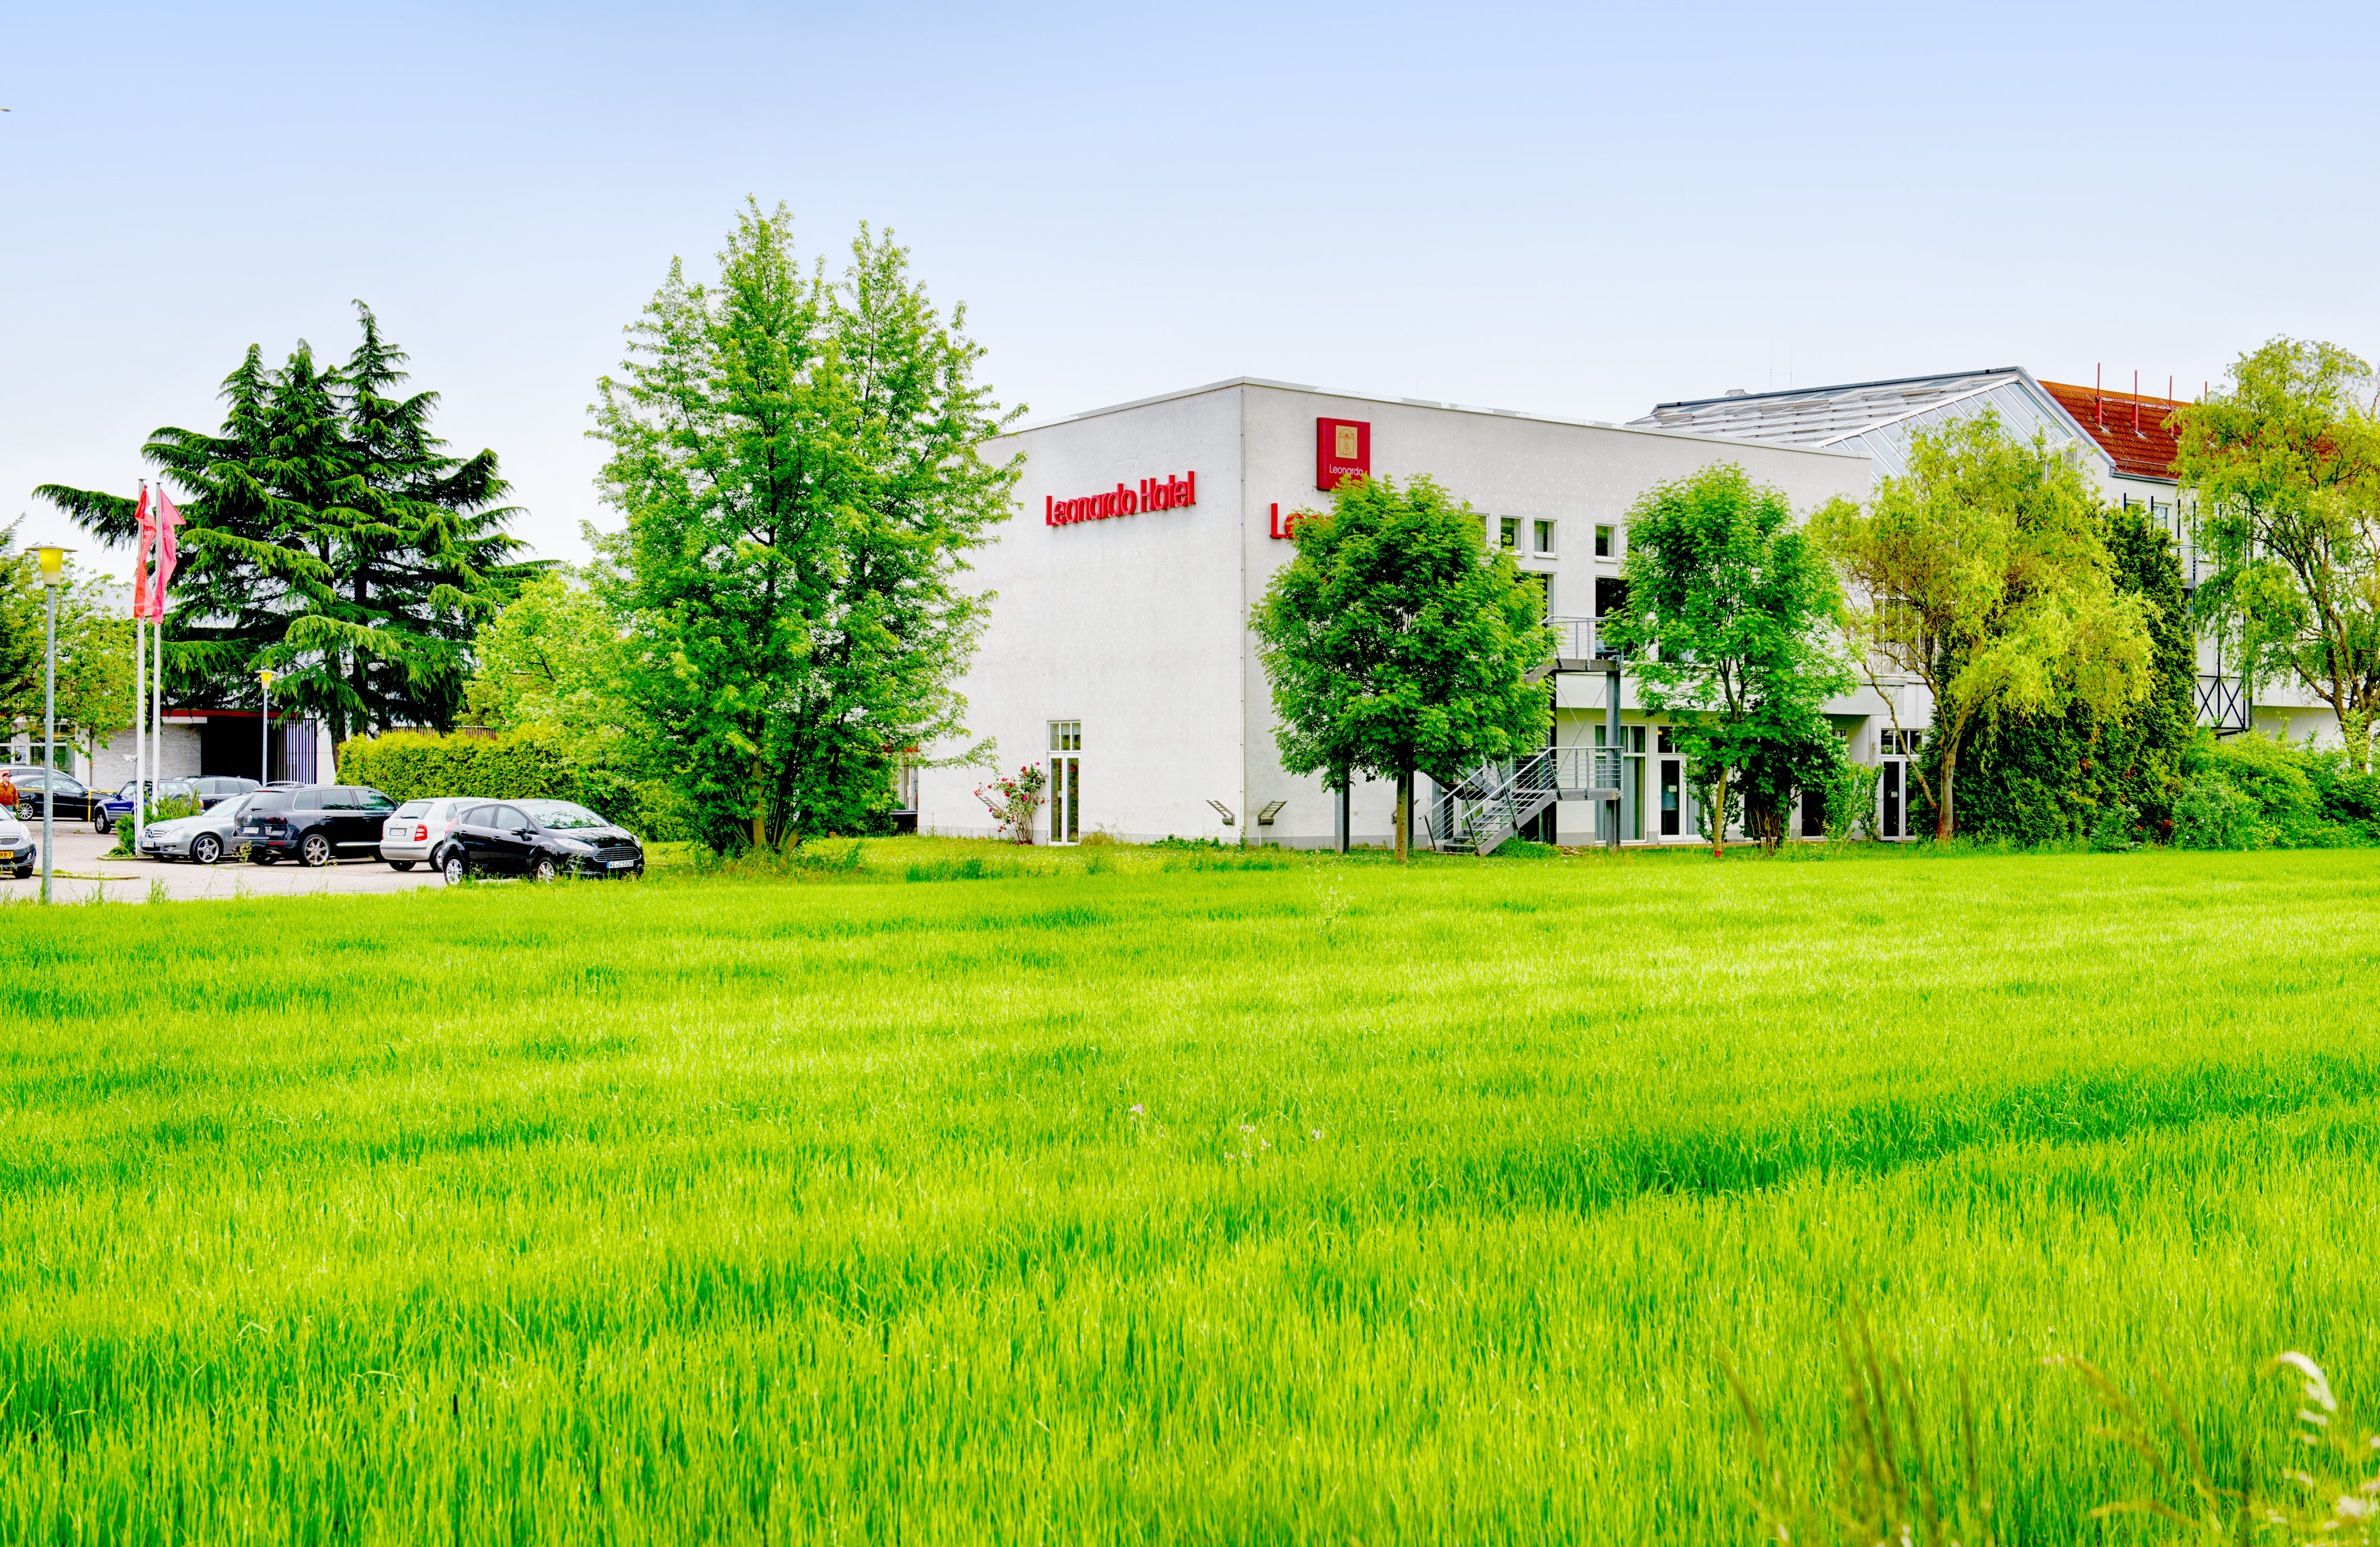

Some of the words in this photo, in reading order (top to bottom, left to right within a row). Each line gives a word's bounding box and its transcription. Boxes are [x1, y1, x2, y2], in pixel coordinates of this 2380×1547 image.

[1329, 464, 1364, 476] Leonardo
[1045, 483, 1137, 527] Leonardo
[1140, 471, 1195, 513] Hotel
